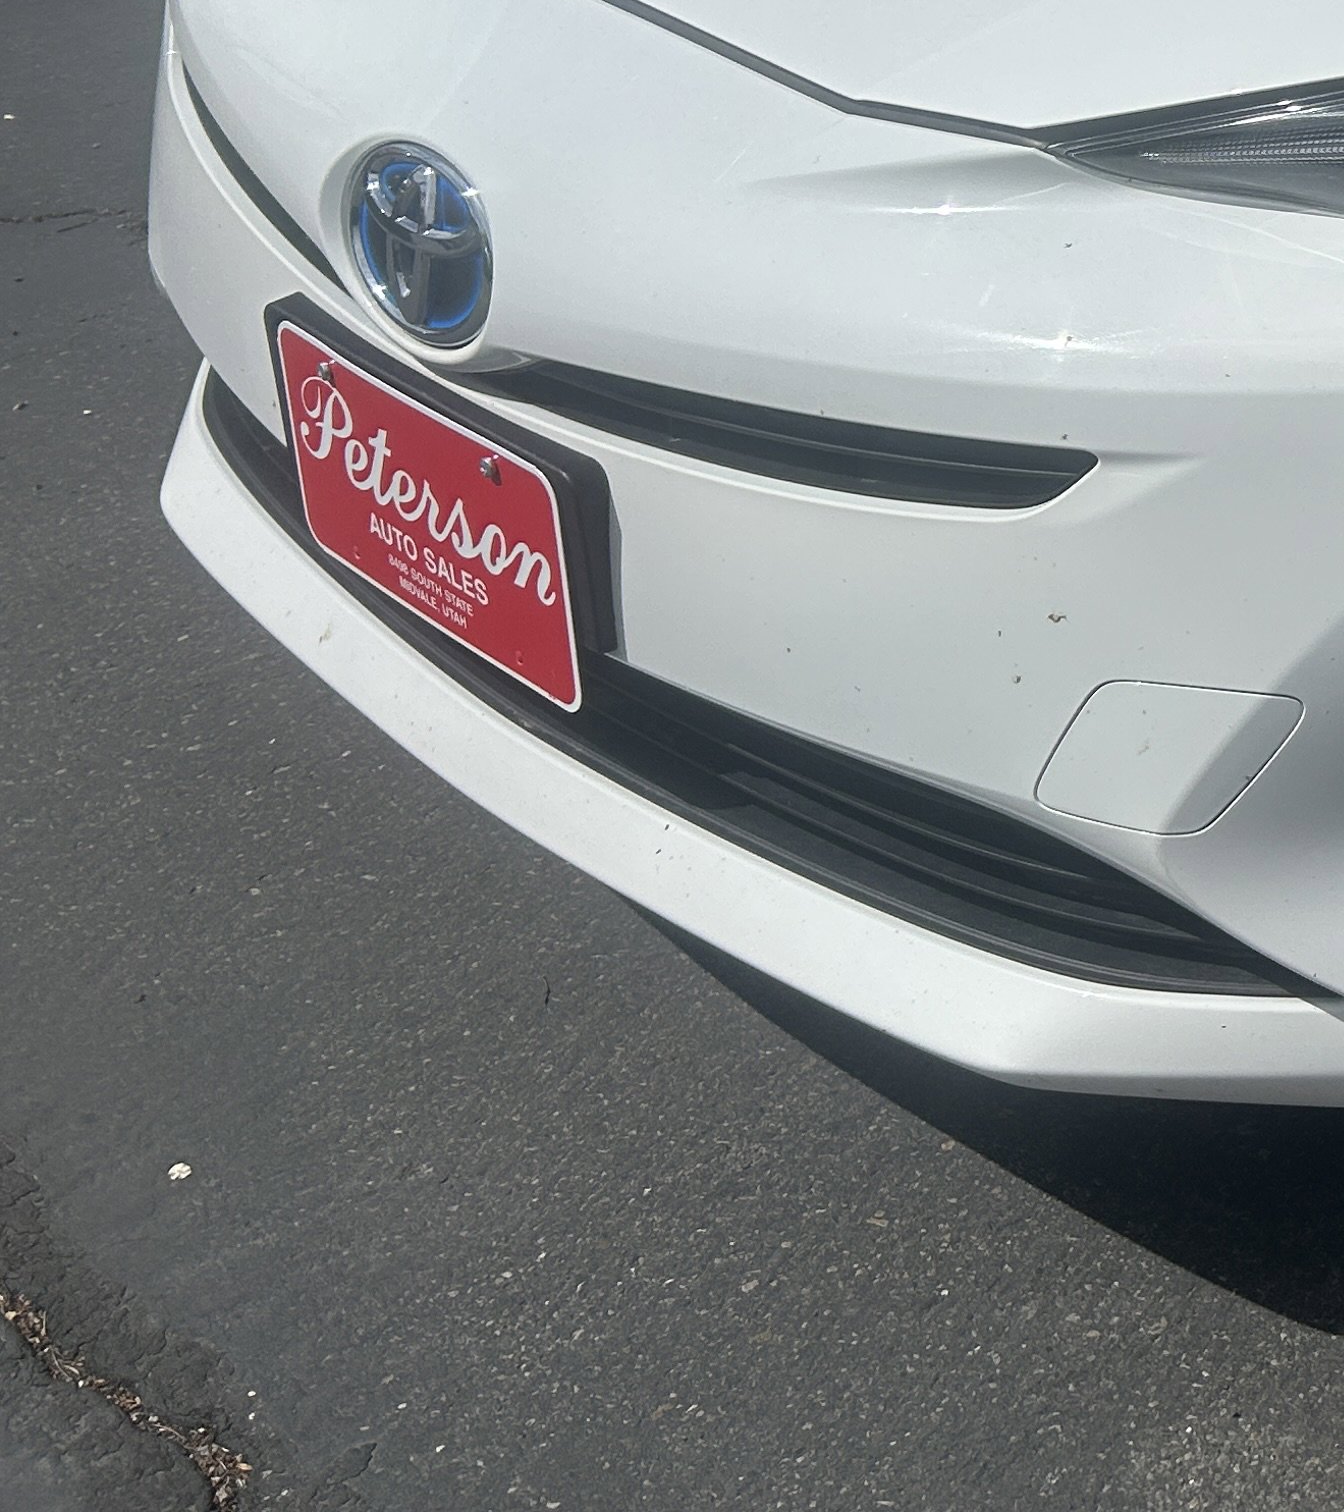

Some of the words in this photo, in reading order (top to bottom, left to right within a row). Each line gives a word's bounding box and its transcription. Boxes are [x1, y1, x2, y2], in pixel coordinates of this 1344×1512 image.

[300, 376, 556, 606] Peterson
[369, 511, 418, 562] AUTO
[423, 546, 489, 605] SALES
[411, 567, 442, 597] SOUTH
[444, 589, 474, 617] STATE
[442, 603, 467, 629] UTAH
